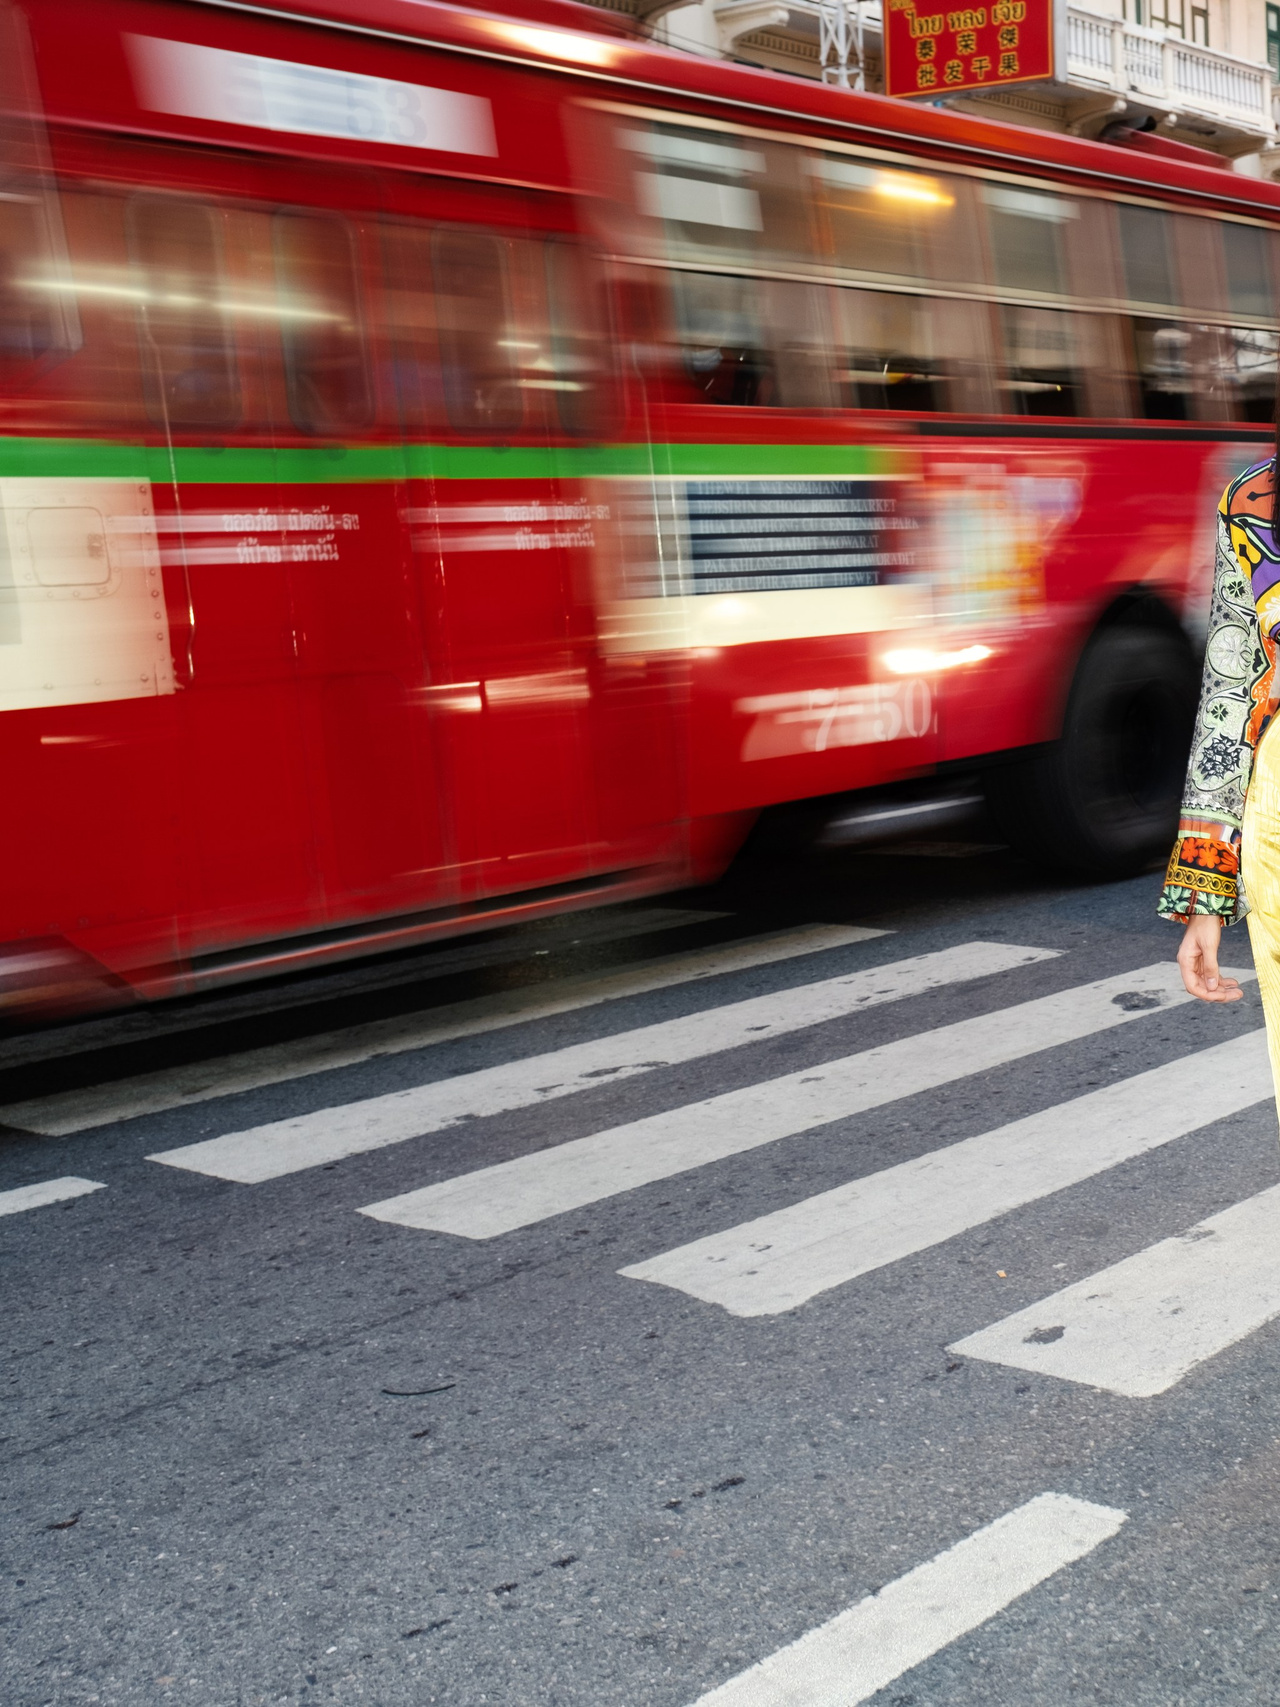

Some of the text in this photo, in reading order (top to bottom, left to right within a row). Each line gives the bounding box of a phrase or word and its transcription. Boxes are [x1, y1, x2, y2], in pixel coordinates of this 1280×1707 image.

[915, 52, 1019, 87] 批发干果
[345, 77, 428, 143] 53
